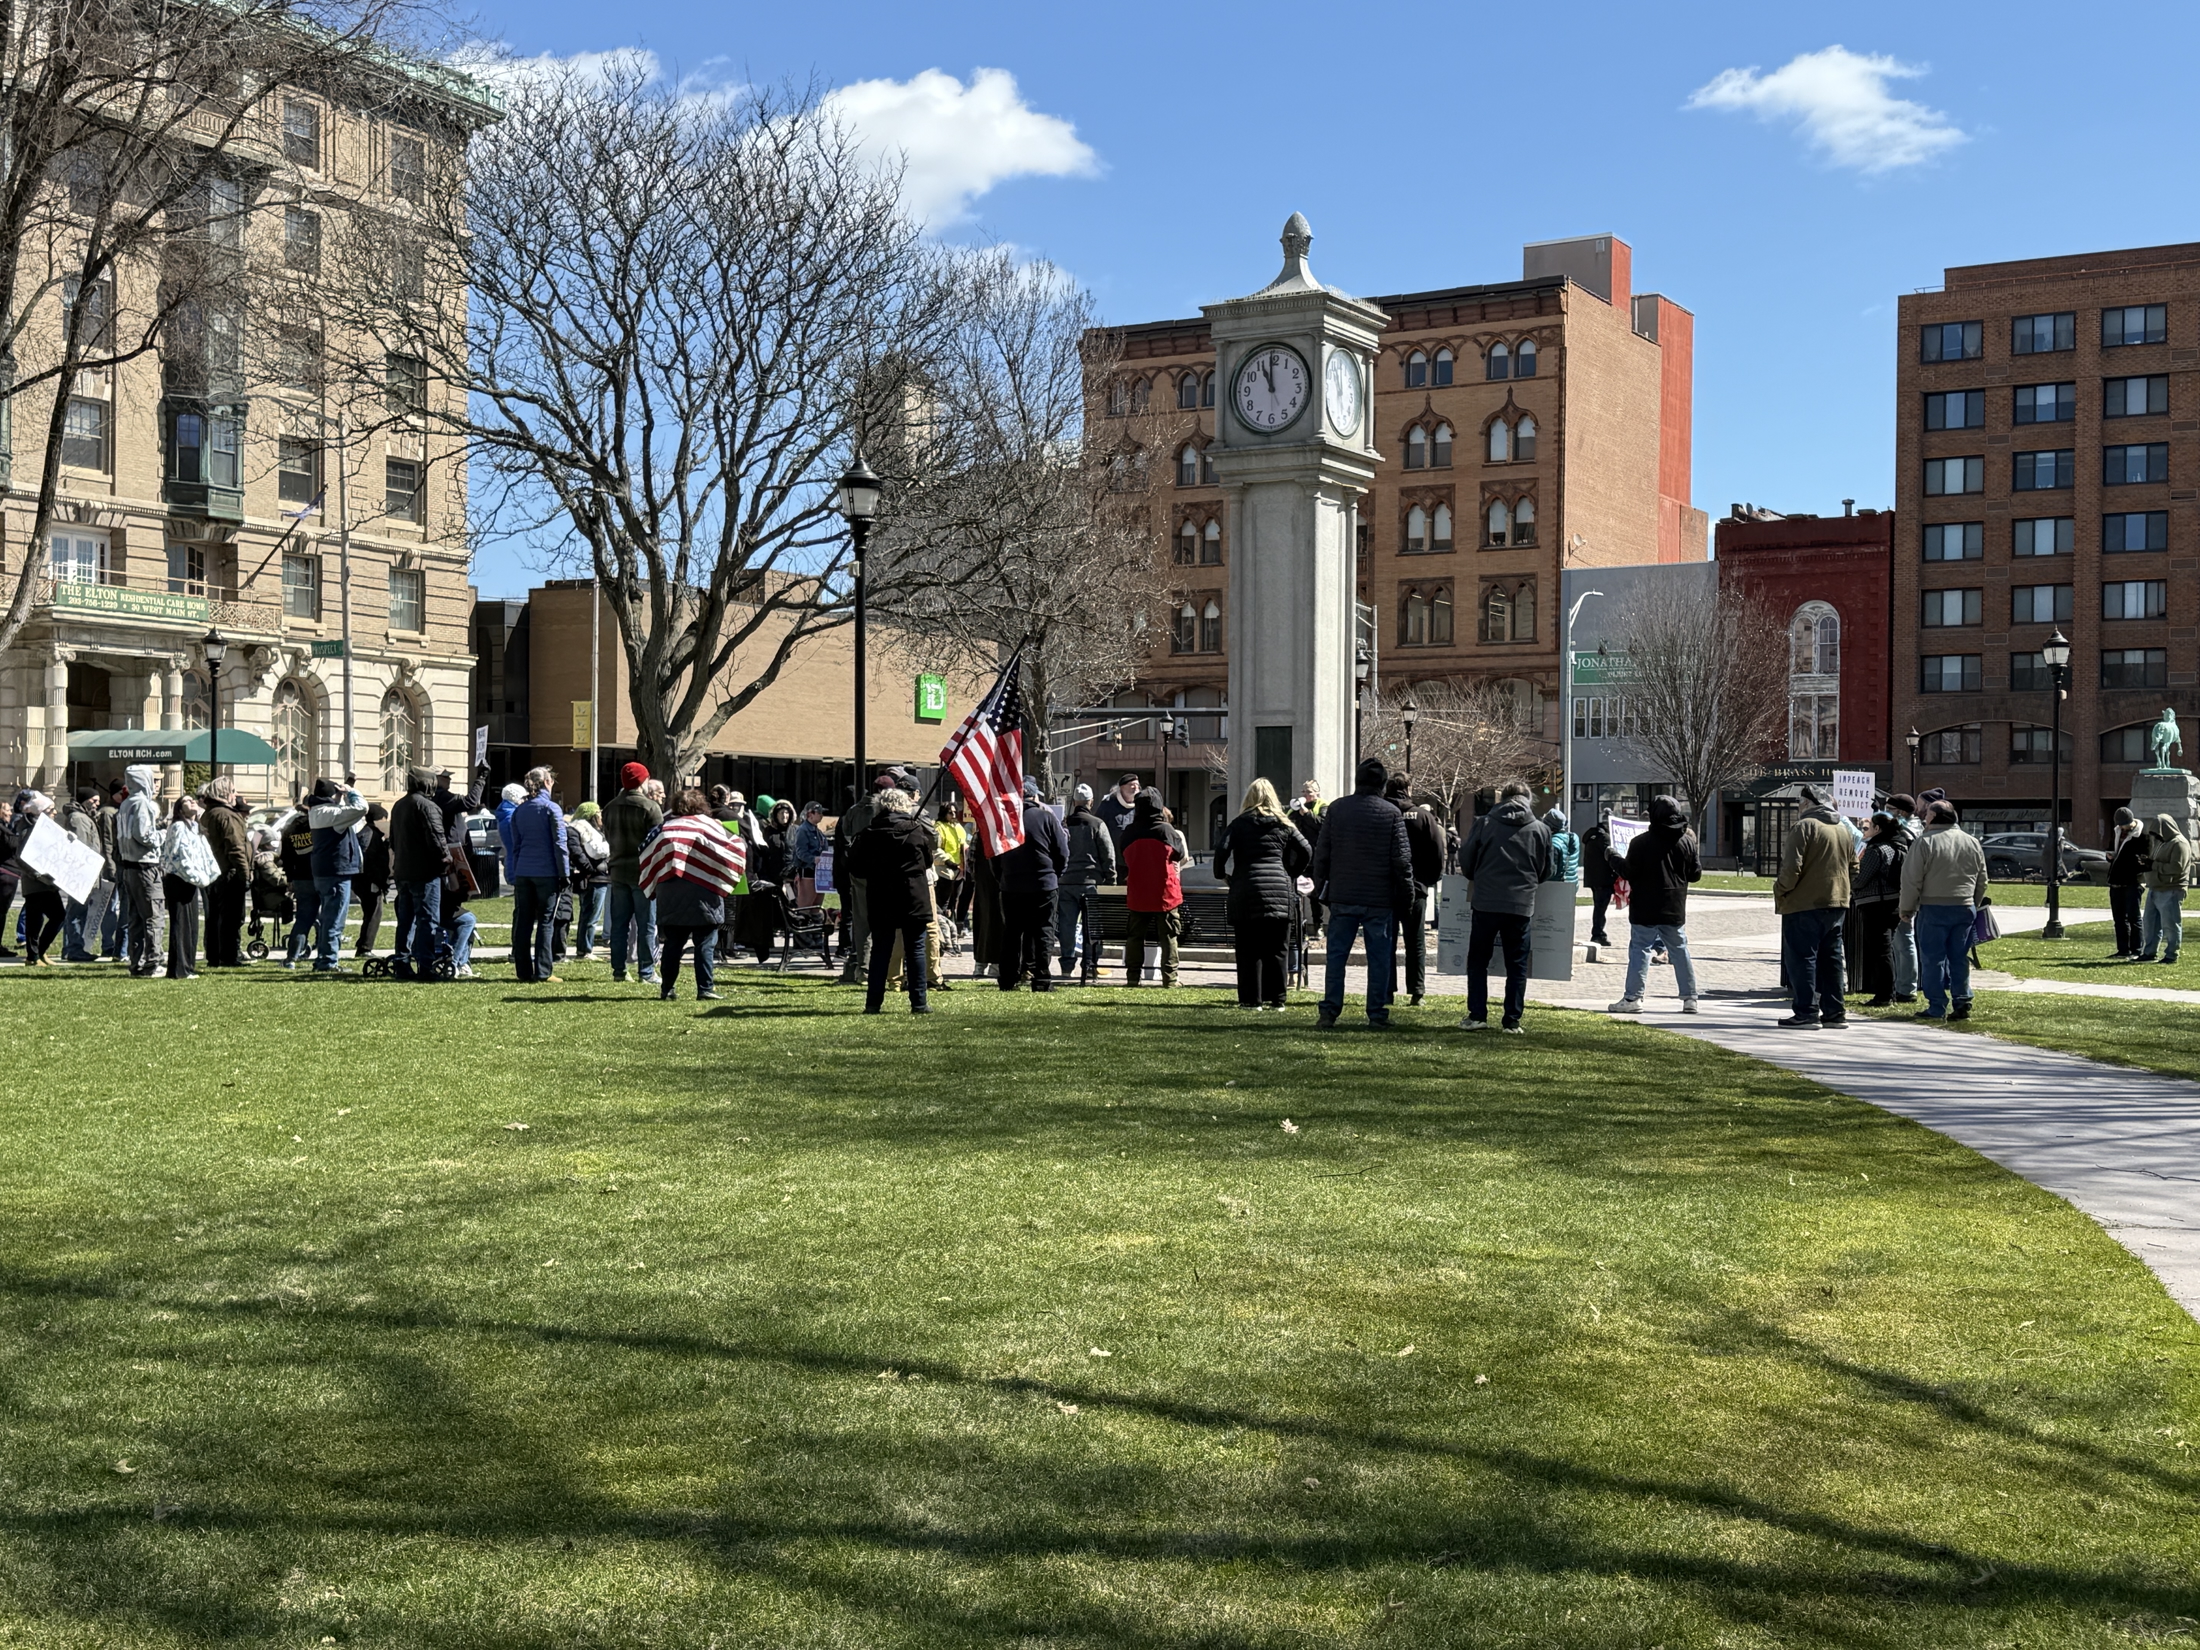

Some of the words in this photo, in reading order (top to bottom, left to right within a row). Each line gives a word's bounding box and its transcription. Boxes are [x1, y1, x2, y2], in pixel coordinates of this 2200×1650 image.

[1284, 358, 1289, 369] 1
[1247, 371, 1257, 383] 10
[1292, 368, 1300, 379] 2
[1243, 386, 1251, 397] 9
[1294, 382, 1302, 394] 3
[1246, 400, 1254, 411] 8
[1289, 397, 1297, 408] 4
[1256, 410, 1263, 421] 7
[1268, 413, 1275, 424] 6
[1281, 408, 1288, 420] 5
[60, 585, 82, 597] THE
[85, 587, 118, 601] ELTON
[120, 593, 165, 607] RESIDENTIAL
[166, 599, 185, 609] CARE
[186, 601, 205, 612] HOME
[142, 605, 163, 615] WEST
[166, 607, 185, 618] MAIN
[1577, 656, 1641, 670] JONATHA
[925, 683, 944, 710] TD
[109, 749, 134, 758] ELTON
[1774, 768, 1815, 777] BRASS
[1839, 775, 1870, 785] IMPEACH
[1839, 788, 1869, 799] REMOVE
[1838, 800, 1869, 809] CONVICT
[1975, 809, 2010, 820] Candy
[2017, 809, 2049, 820] World
